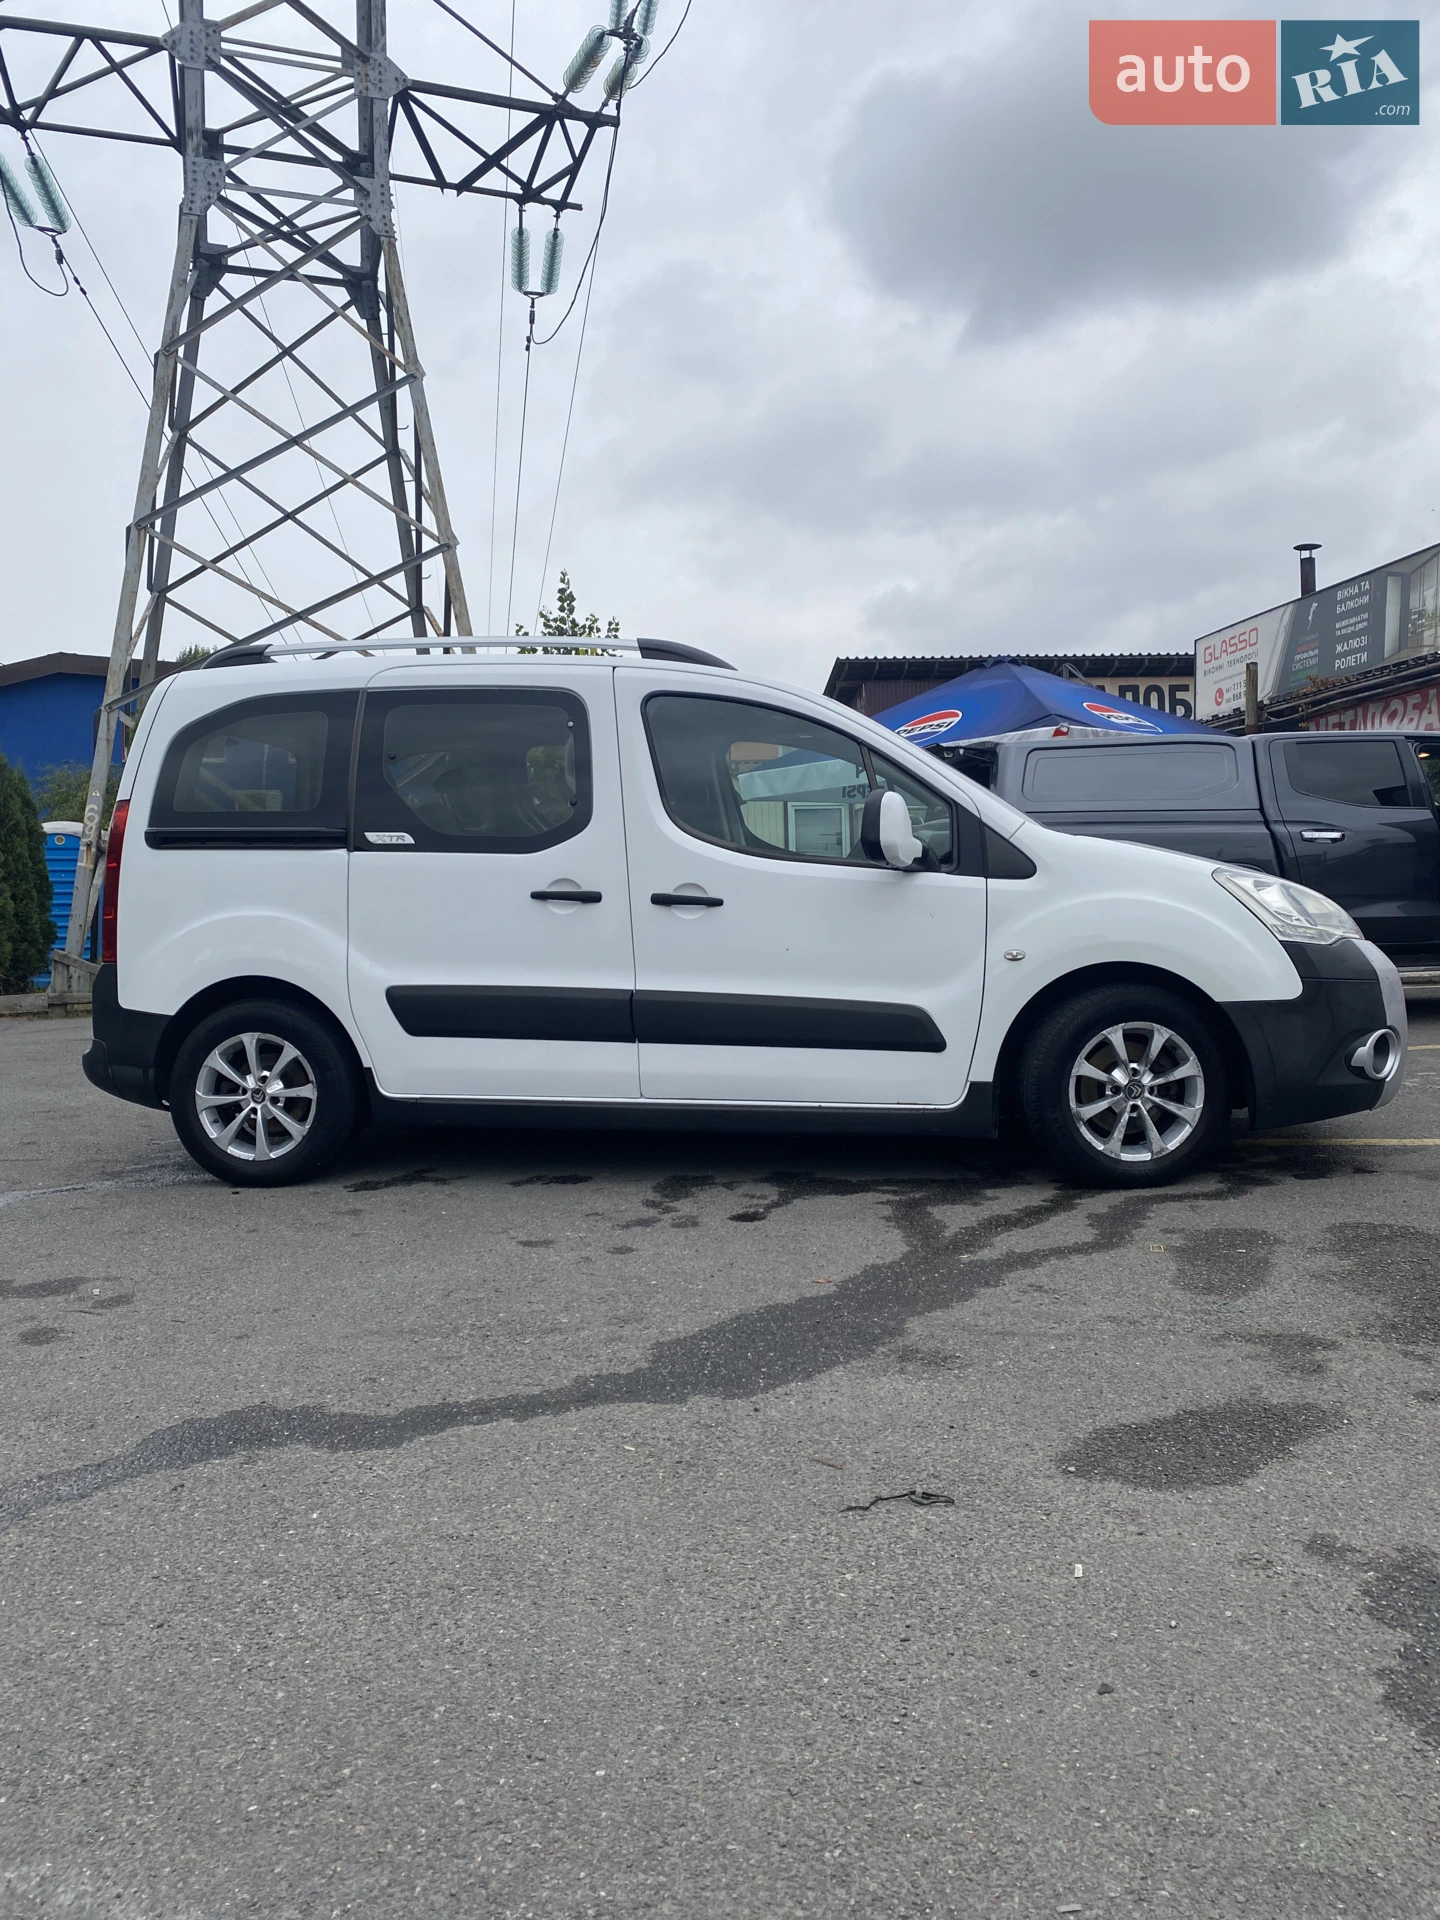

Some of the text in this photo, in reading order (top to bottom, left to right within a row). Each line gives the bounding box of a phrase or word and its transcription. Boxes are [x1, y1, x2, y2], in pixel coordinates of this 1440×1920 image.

[1337, 580, 1370, 600] ВІКНА ТА
[1336, 594, 1369, 614] БАЛКОНИ
[1204, 627, 1258, 664] GLASSO
[1335, 635, 1368, 654] ЖАЛЮЗІ
[1203, 648, 1259, 677] ВІКОННІ ТЕХНОЛОГІЇ
[1292, 656, 1319, 671] СИСТЕМИ
[1335, 651, 1368, 671] РОЛЕТИ
[896, 720, 955, 735] PEPSI
[373, 833, 406, 843] XTR
